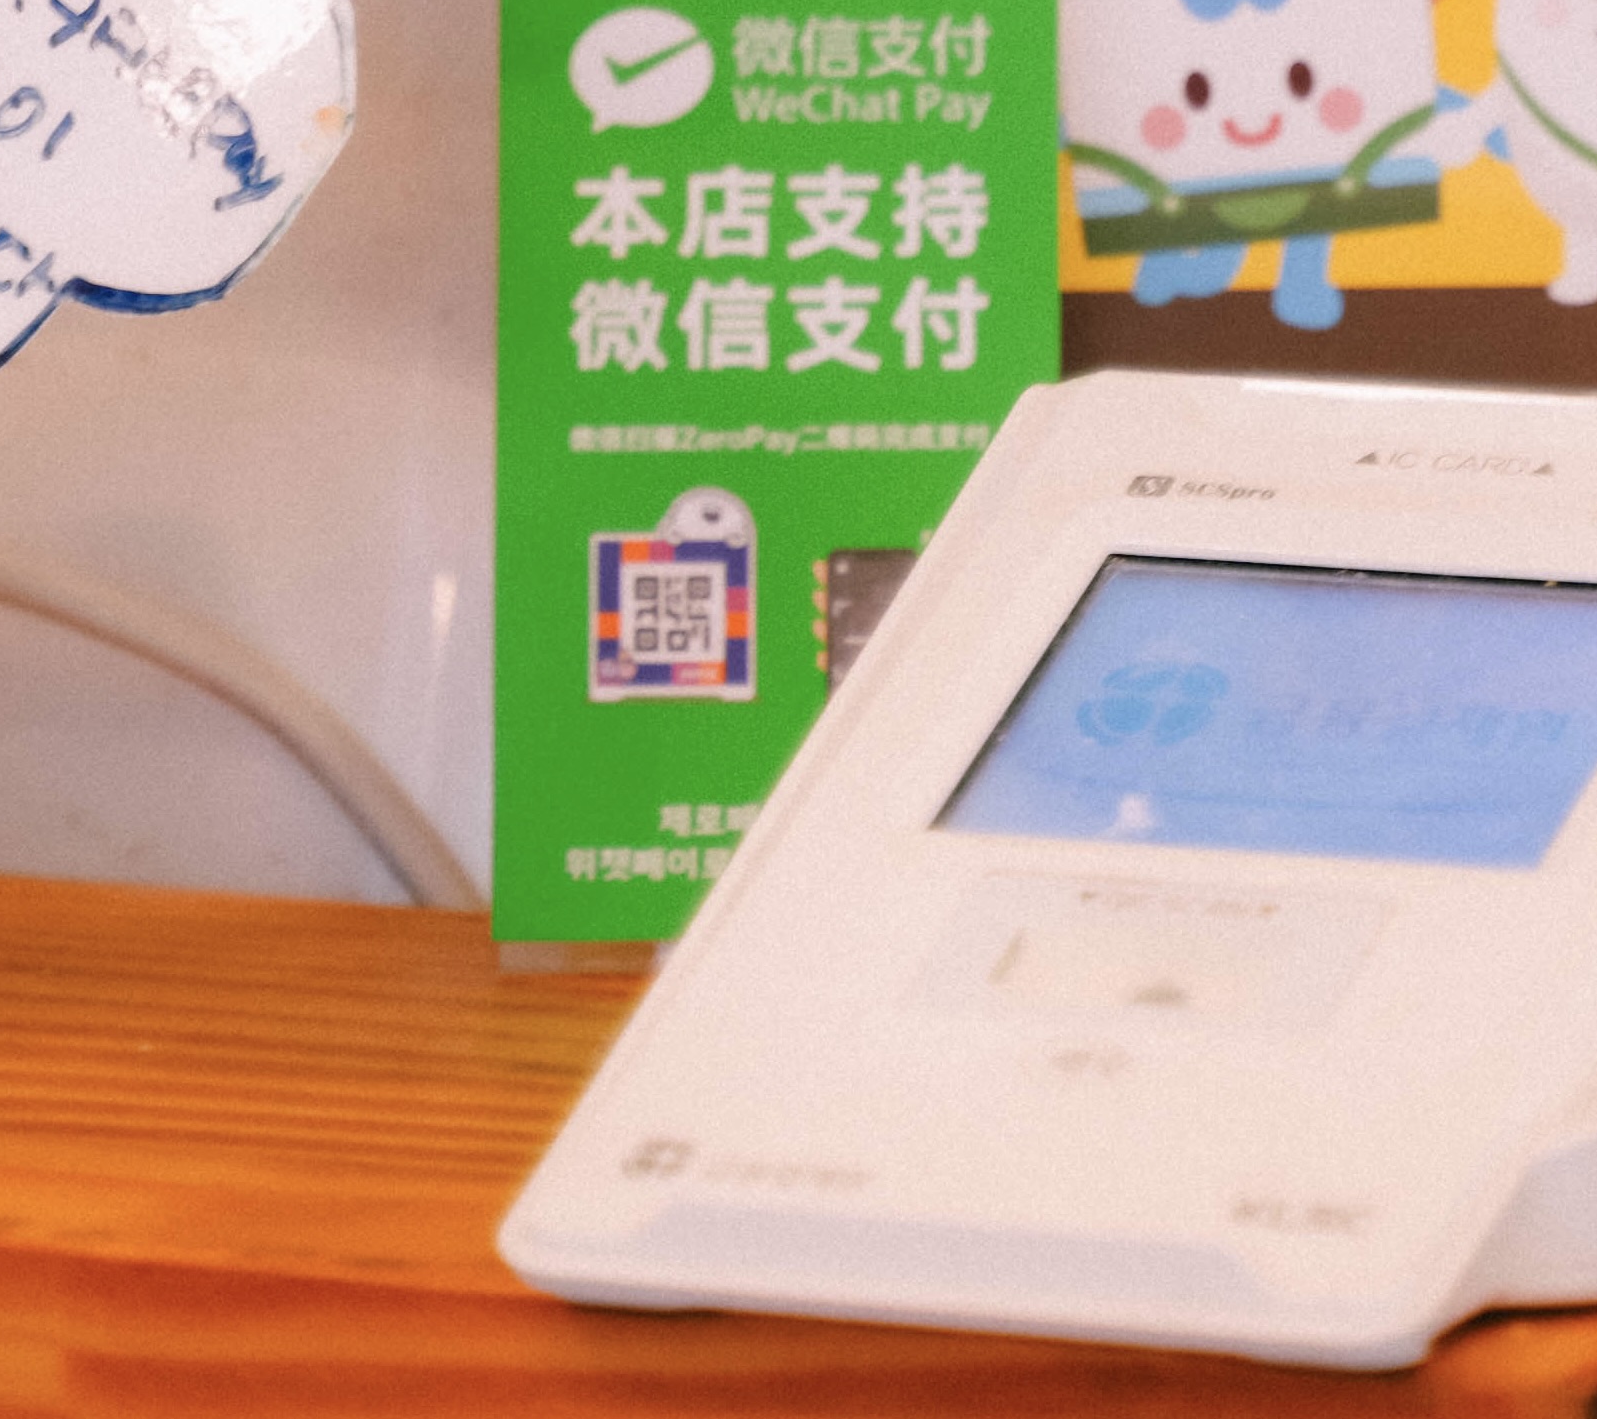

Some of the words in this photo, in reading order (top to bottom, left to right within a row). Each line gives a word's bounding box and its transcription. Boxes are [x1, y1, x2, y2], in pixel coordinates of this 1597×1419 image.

[731, 14, 992, 79] 微信支付
[731, 83, 904, 124] WeChat
[914, 84, 992, 132] Pay
[569, 162, 990, 261] 本店支持
[569, 275, 992, 374] 微信支付
